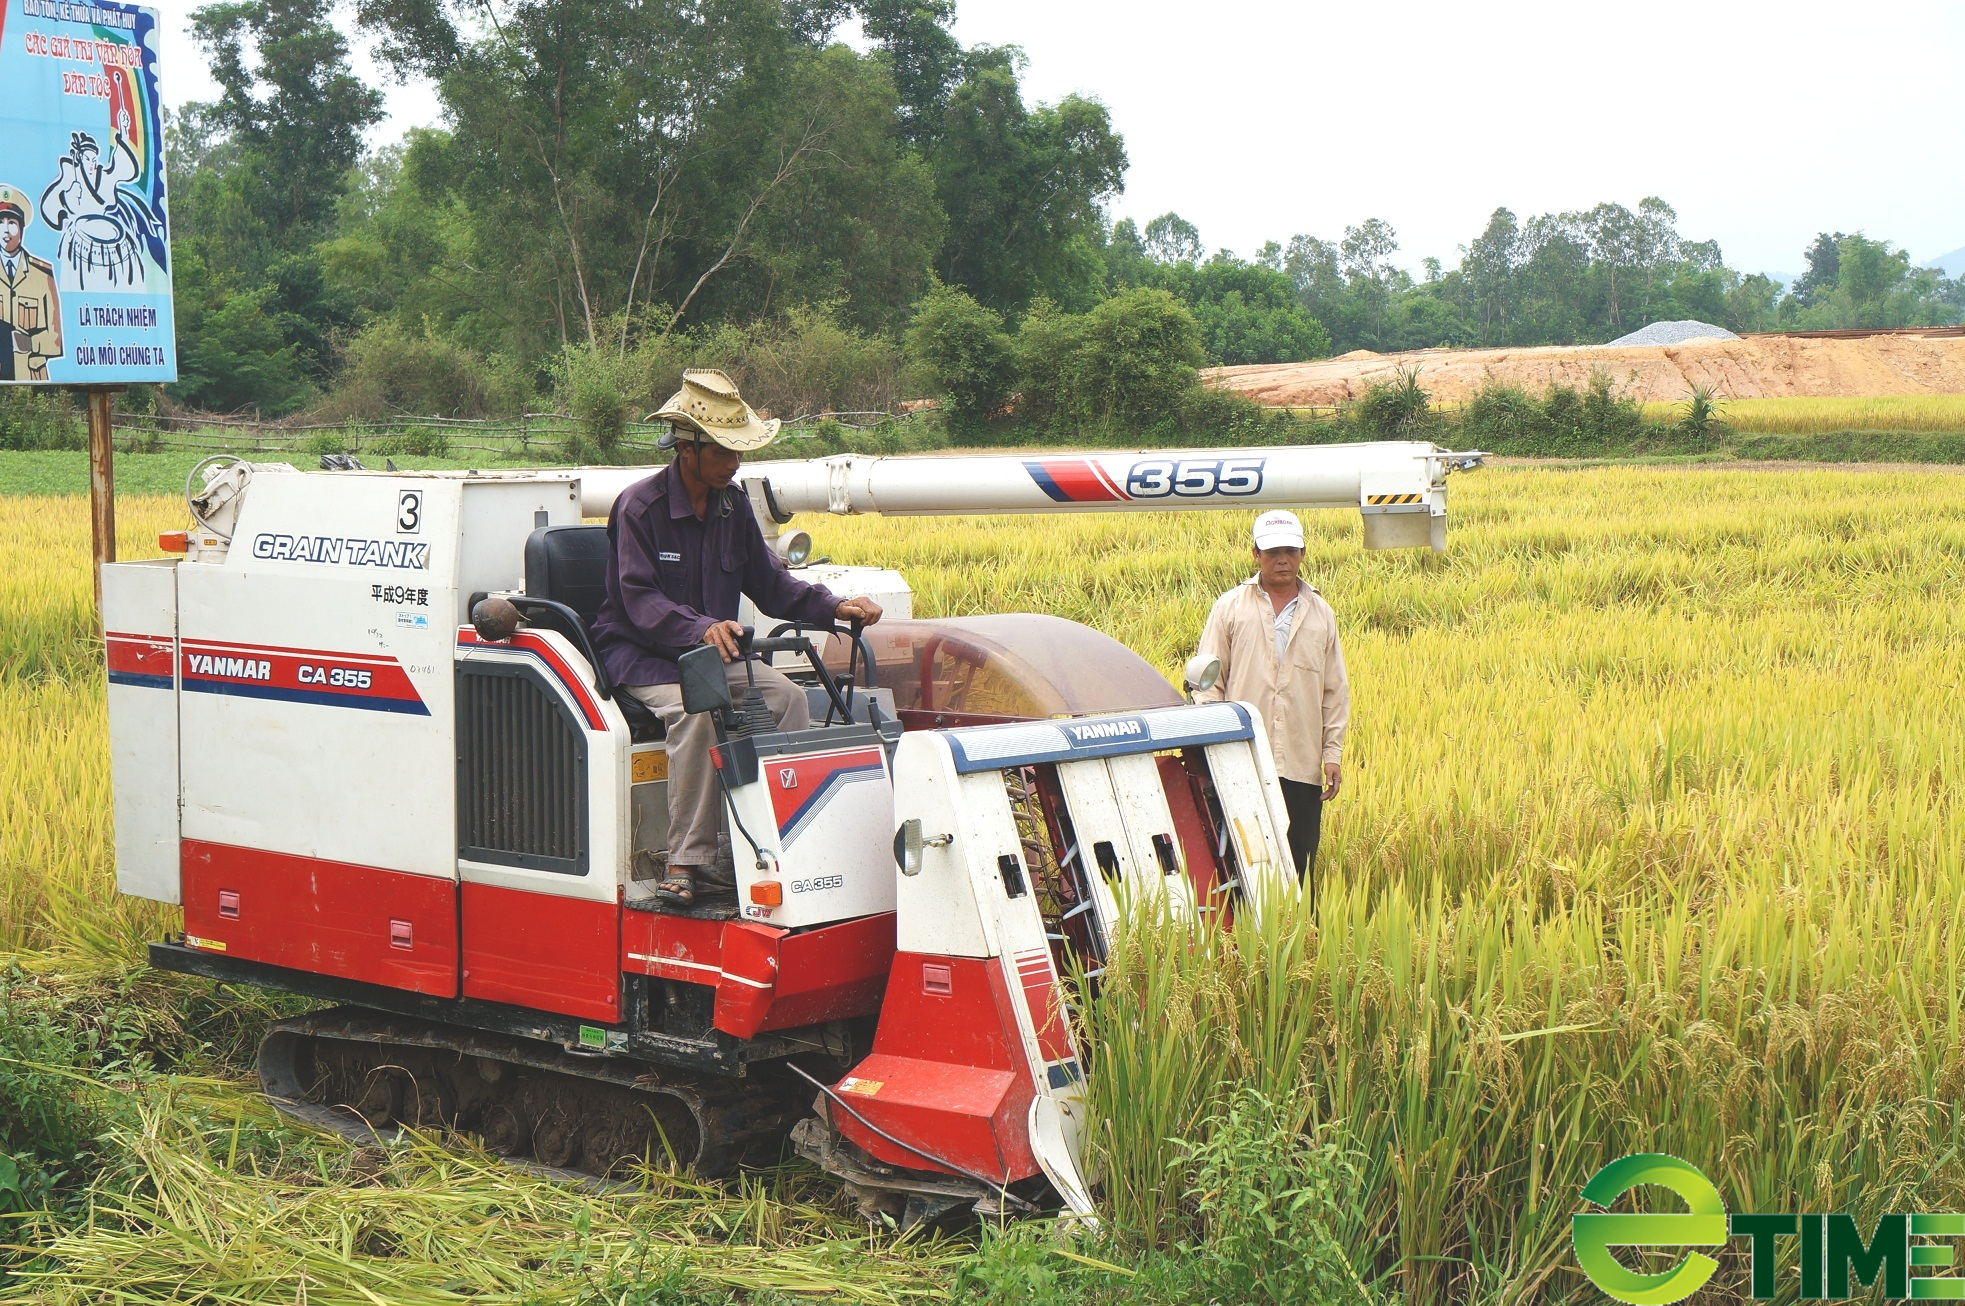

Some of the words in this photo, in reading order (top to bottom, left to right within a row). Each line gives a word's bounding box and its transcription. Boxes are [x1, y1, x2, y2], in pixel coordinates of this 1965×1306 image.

[59, 1, 70, 21] KẾ
[70, 3, 91, 24] THỪA
[91, 6, 102, 25] VÀ
[102, 8, 121, 28] PHÁT
[121, 12, 136, 30] HUY
[25, 31, 47, 56] CÁC
[51, 34, 71, 59] GIÁ
[73, 40, 93, 65] TRỊ
[95, 37, 117, 65] VĂN
[88, 73, 111, 101] TỘC
[79, 303, 91, 326] LÀ
[93, 303, 124, 327] TRÁCH
[126, 304, 156, 331] NHIỆM
[76, 338, 96, 365] CỦA
[98, 339, 117, 365] MỖI
[119, 342, 151, 366] CHÚNG
[153, 347, 165, 366] TA
[1126, 457, 1267, 498] 355
[399, 493, 419, 530] 3
[253, 533, 344, 564] GRAIN
[345, 538, 428, 570] TANK
[371, 584, 429, 607] 平成9年度
[188, 653, 271, 681] YANMAR
[1069, 720, 1141, 740] YANMAR
